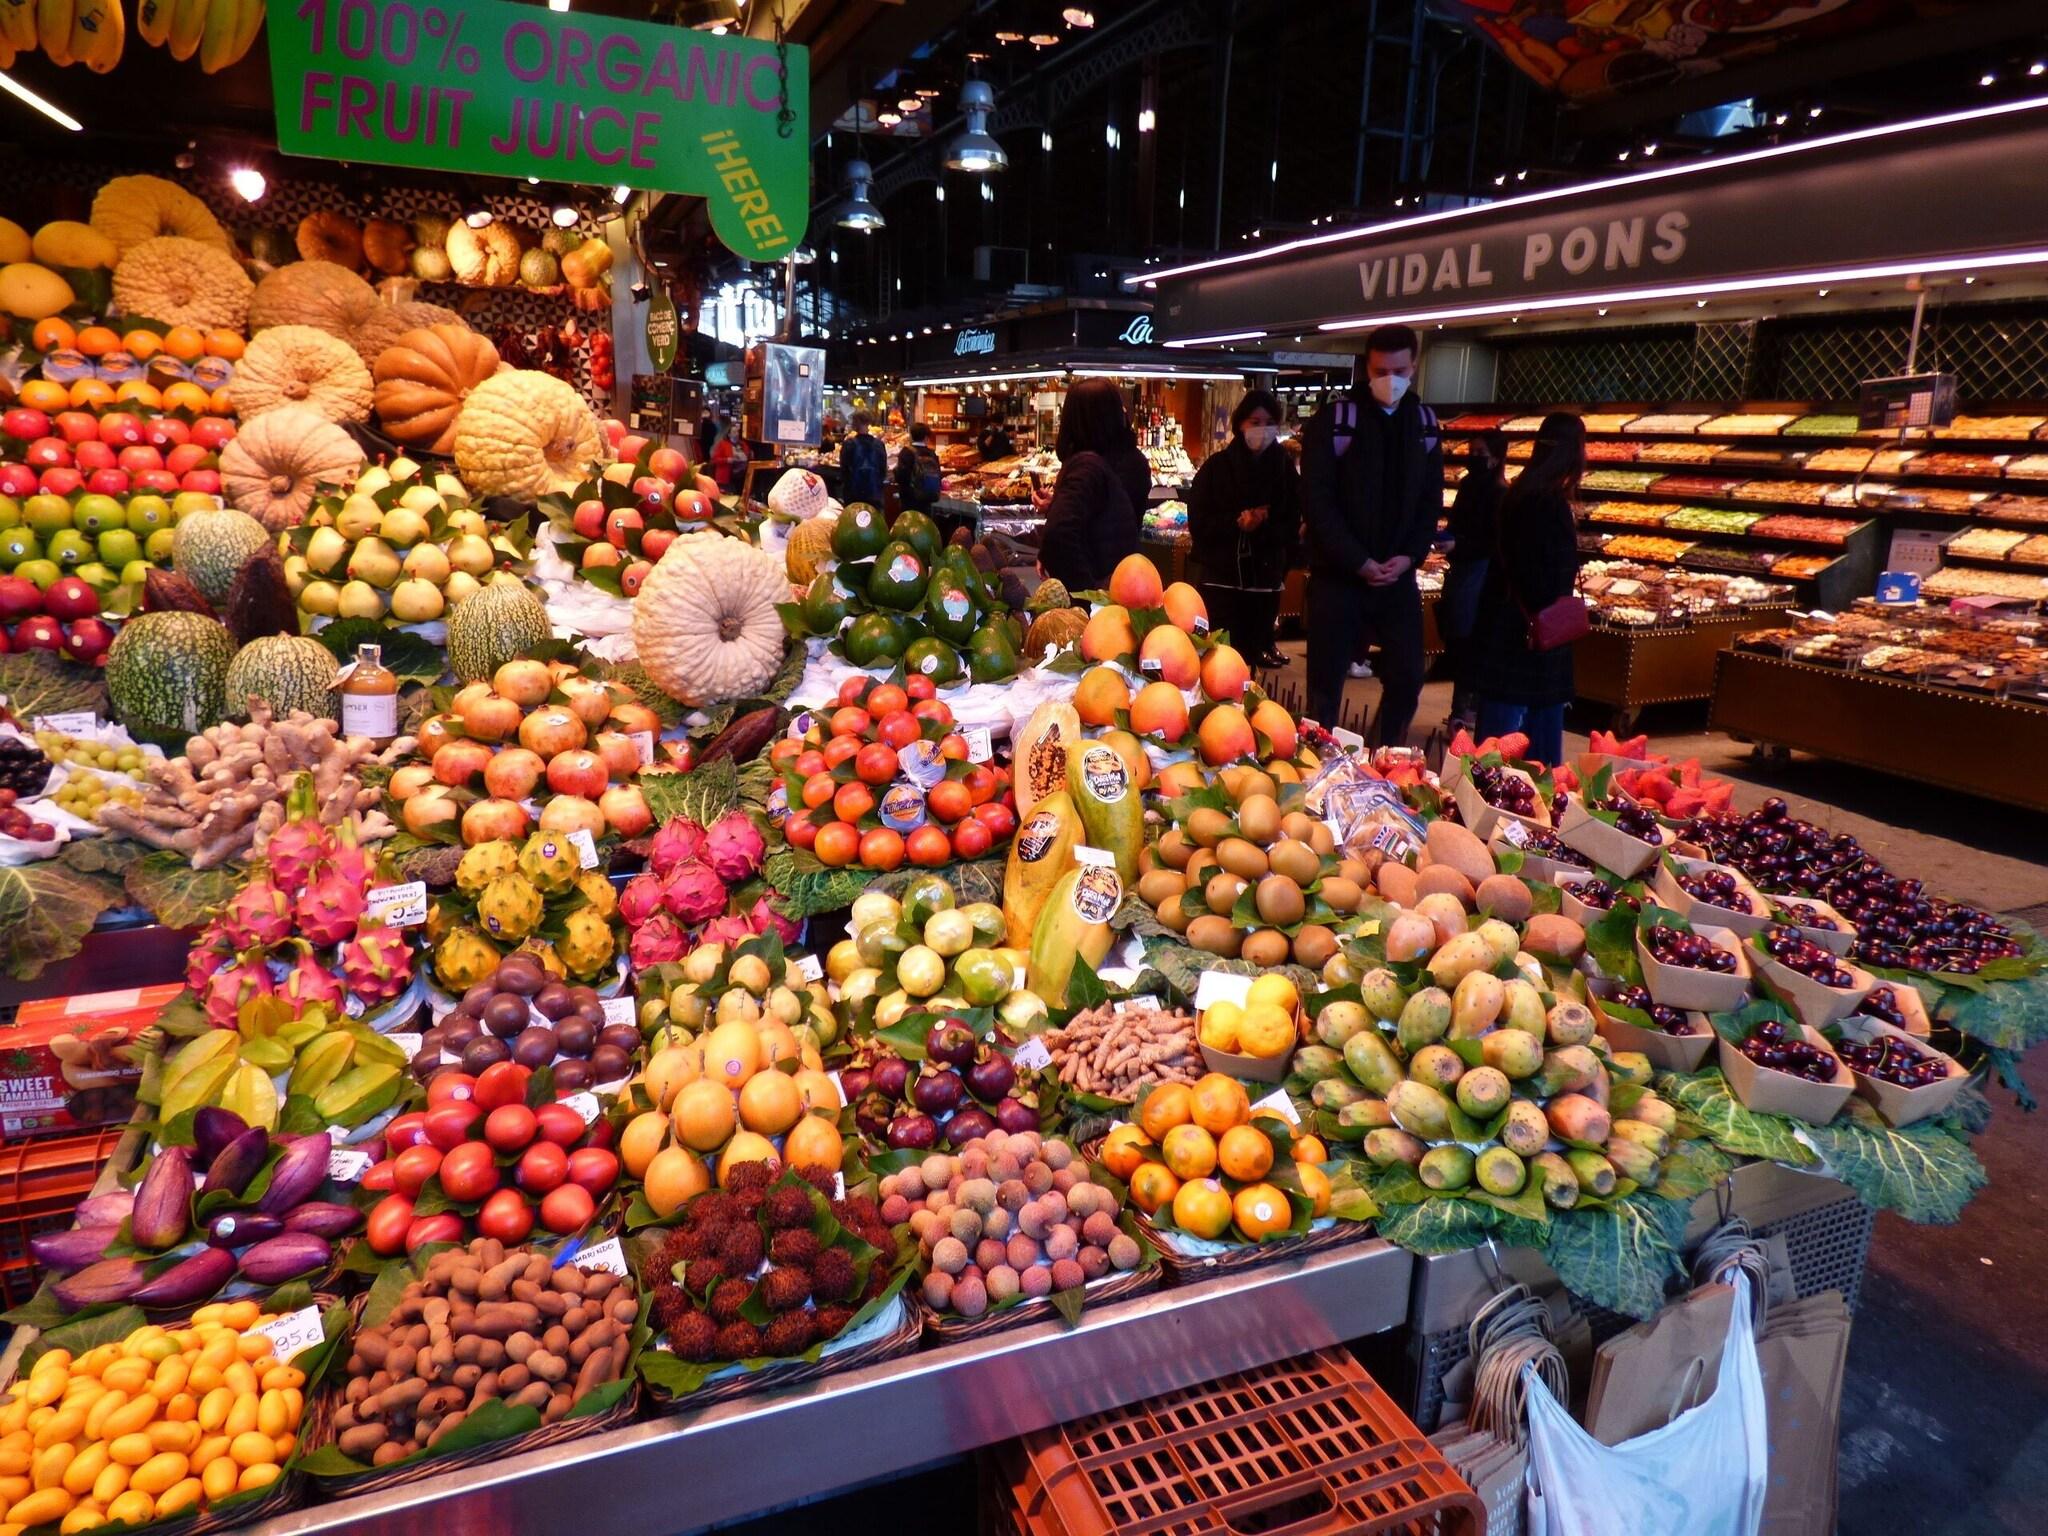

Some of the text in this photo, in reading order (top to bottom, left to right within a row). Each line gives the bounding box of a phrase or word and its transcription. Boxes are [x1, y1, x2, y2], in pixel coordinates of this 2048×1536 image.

[297, 0, 783, 112] 100% ORGANIC
[301, 71, 662, 169] FRUIT JUICE
[1359, 210, 1690, 301] VIDAL PONS
[0, 1076, 54, 1092] SWEET
[574, 1243, 614, 1262] MARINDO
